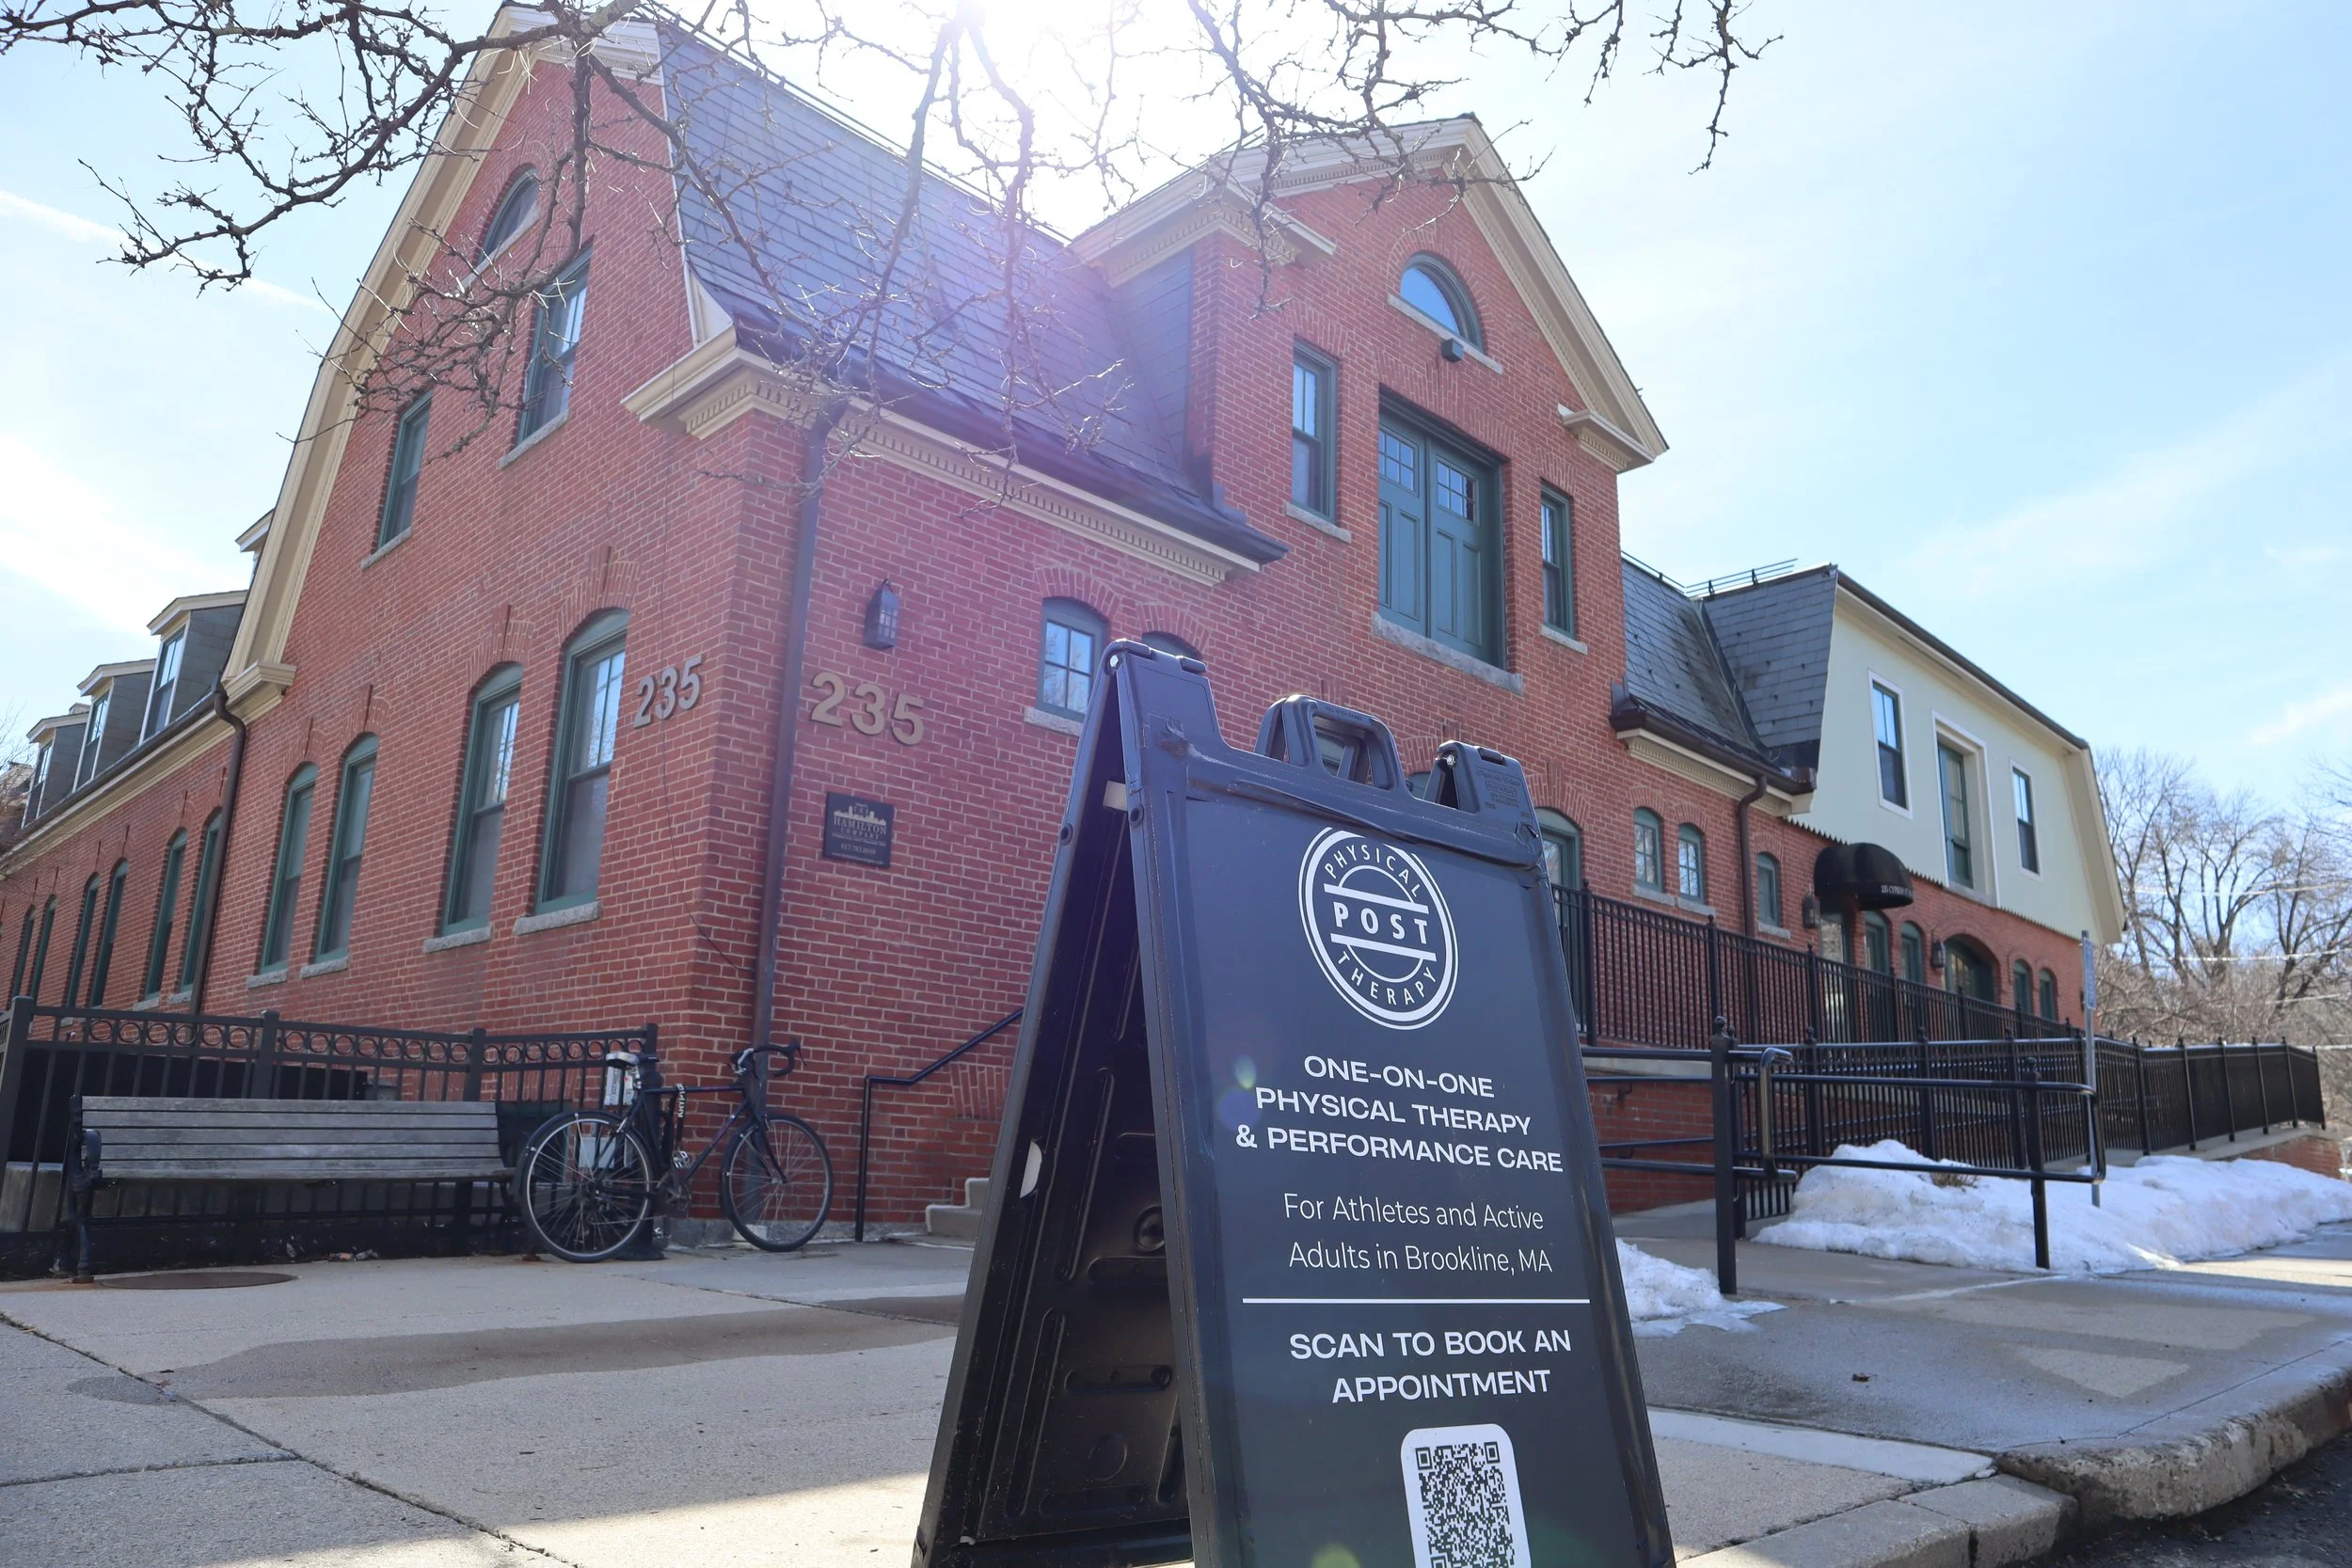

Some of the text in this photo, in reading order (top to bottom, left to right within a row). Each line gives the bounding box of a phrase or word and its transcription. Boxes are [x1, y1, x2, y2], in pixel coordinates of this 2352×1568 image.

[633, 654, 702, 729] 235
[809, 672, 926, 746] 235
[834, 816, 886, 834] HAMILTON
[1325, 845, 1420, 896] PHYSICAL
[1333, 902, 1428, 944] POST
[1339, 951, 1437, 1005] THERAPY
[1305, 1056, 1495, 1098] ONE-ON-ONE
[1256, 1087, 1532, 1135] PHYSICAL THERAPY
[1236, 1125, 1564, 1172] & PERFORMANCE CARE
[1284, 1193, 1544, 1229] For Athletes and Active
[1289, 1242, 1553, 1276] Adults in Brookline, MA
[1290, 1329, 1572, 1359] SCAN TO BOOK AN
[1332, 1370, 1551, 1403] APPOINTMENT
